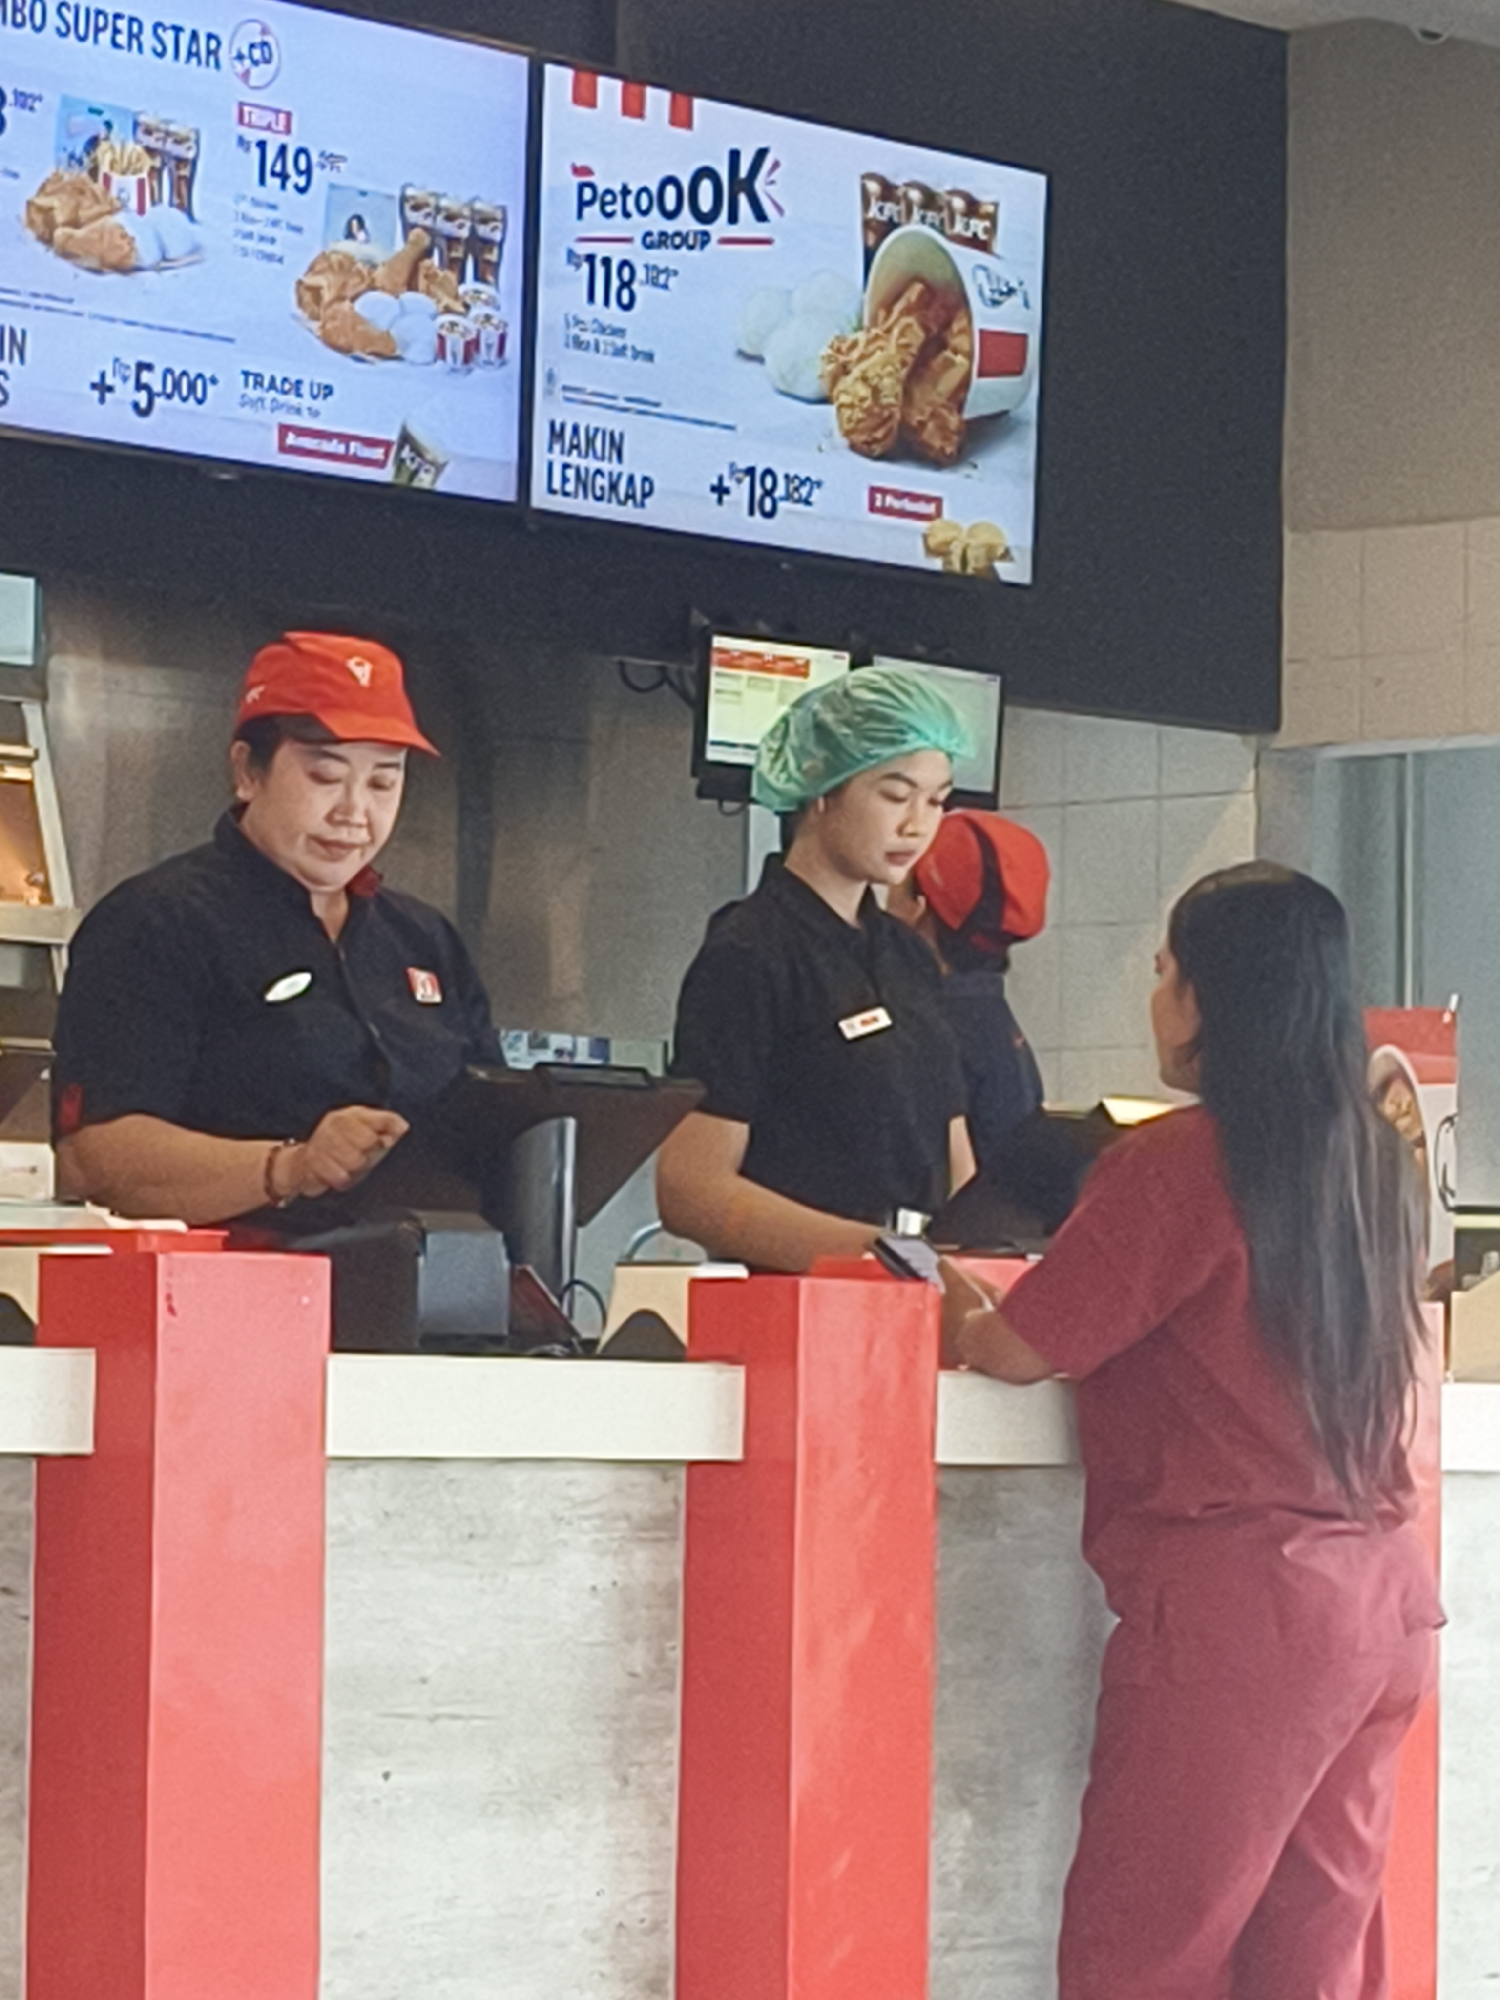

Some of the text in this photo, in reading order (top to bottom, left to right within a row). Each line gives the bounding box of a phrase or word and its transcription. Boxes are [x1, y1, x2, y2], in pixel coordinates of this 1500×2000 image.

[55, 1, 144, 55] SUPER
[151, 21, 222, 71] STAR
[255, 140, 313, 195] 149
[641, 230, 711, 250] GROUP
[240, 369, 334, 401] TRADE UP
[548, 418, 625, 465] MAKIN
[546, 459, 655, 510] LENGKAP
